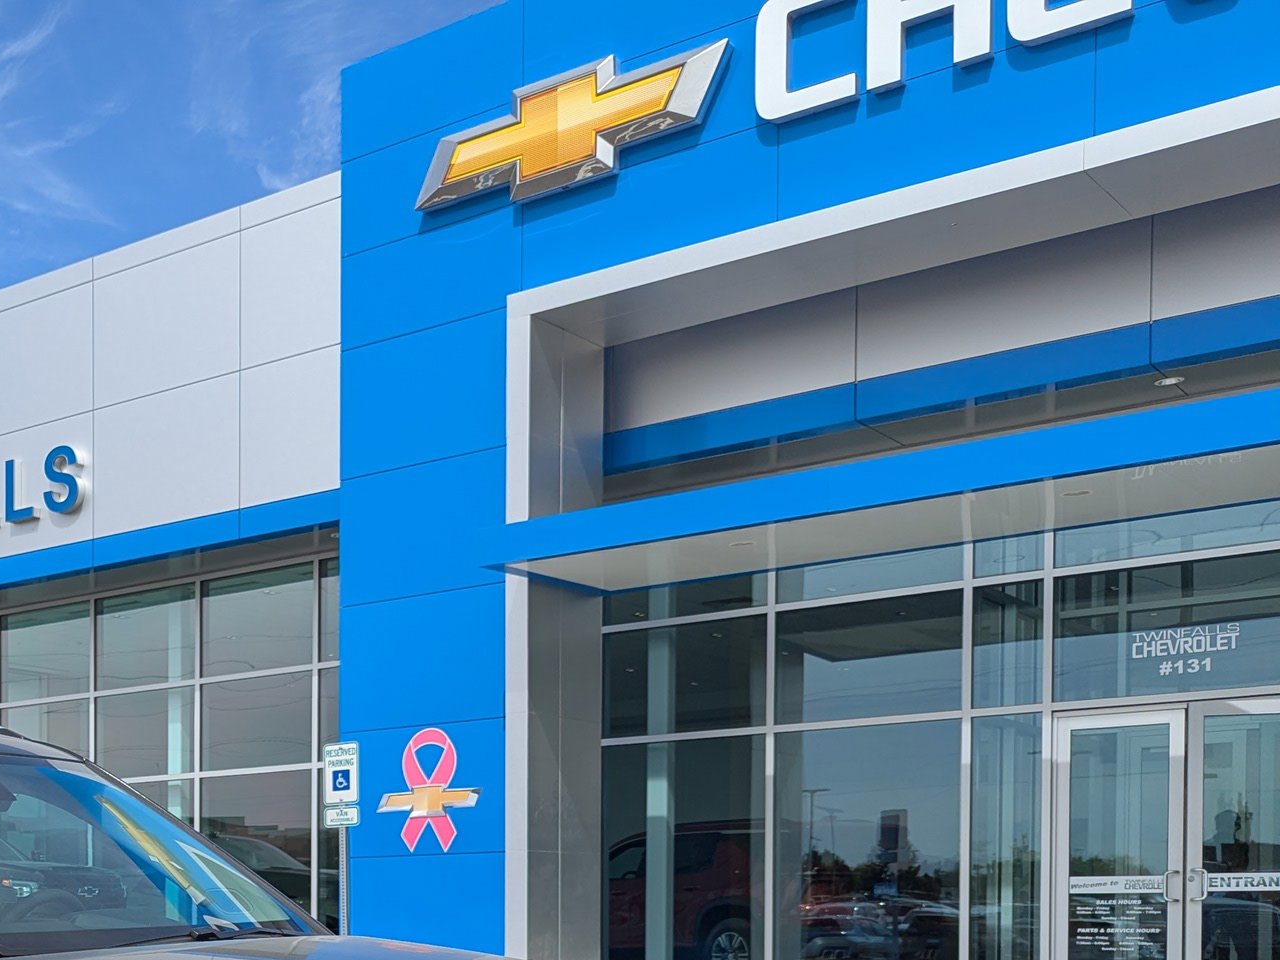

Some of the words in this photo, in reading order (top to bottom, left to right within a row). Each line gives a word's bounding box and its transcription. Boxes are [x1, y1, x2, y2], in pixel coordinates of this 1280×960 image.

[1132, 622, 1240, 642] TWINFALLS
[1132, 633, 1240, 659] CHEVROLET
[1159, 658, 1212, 676] #131
[326, 748, 357, 758] RESERVED
[328, 758, 354, 769] PARKING
[1071, 881, 1107, 889] Welcome
